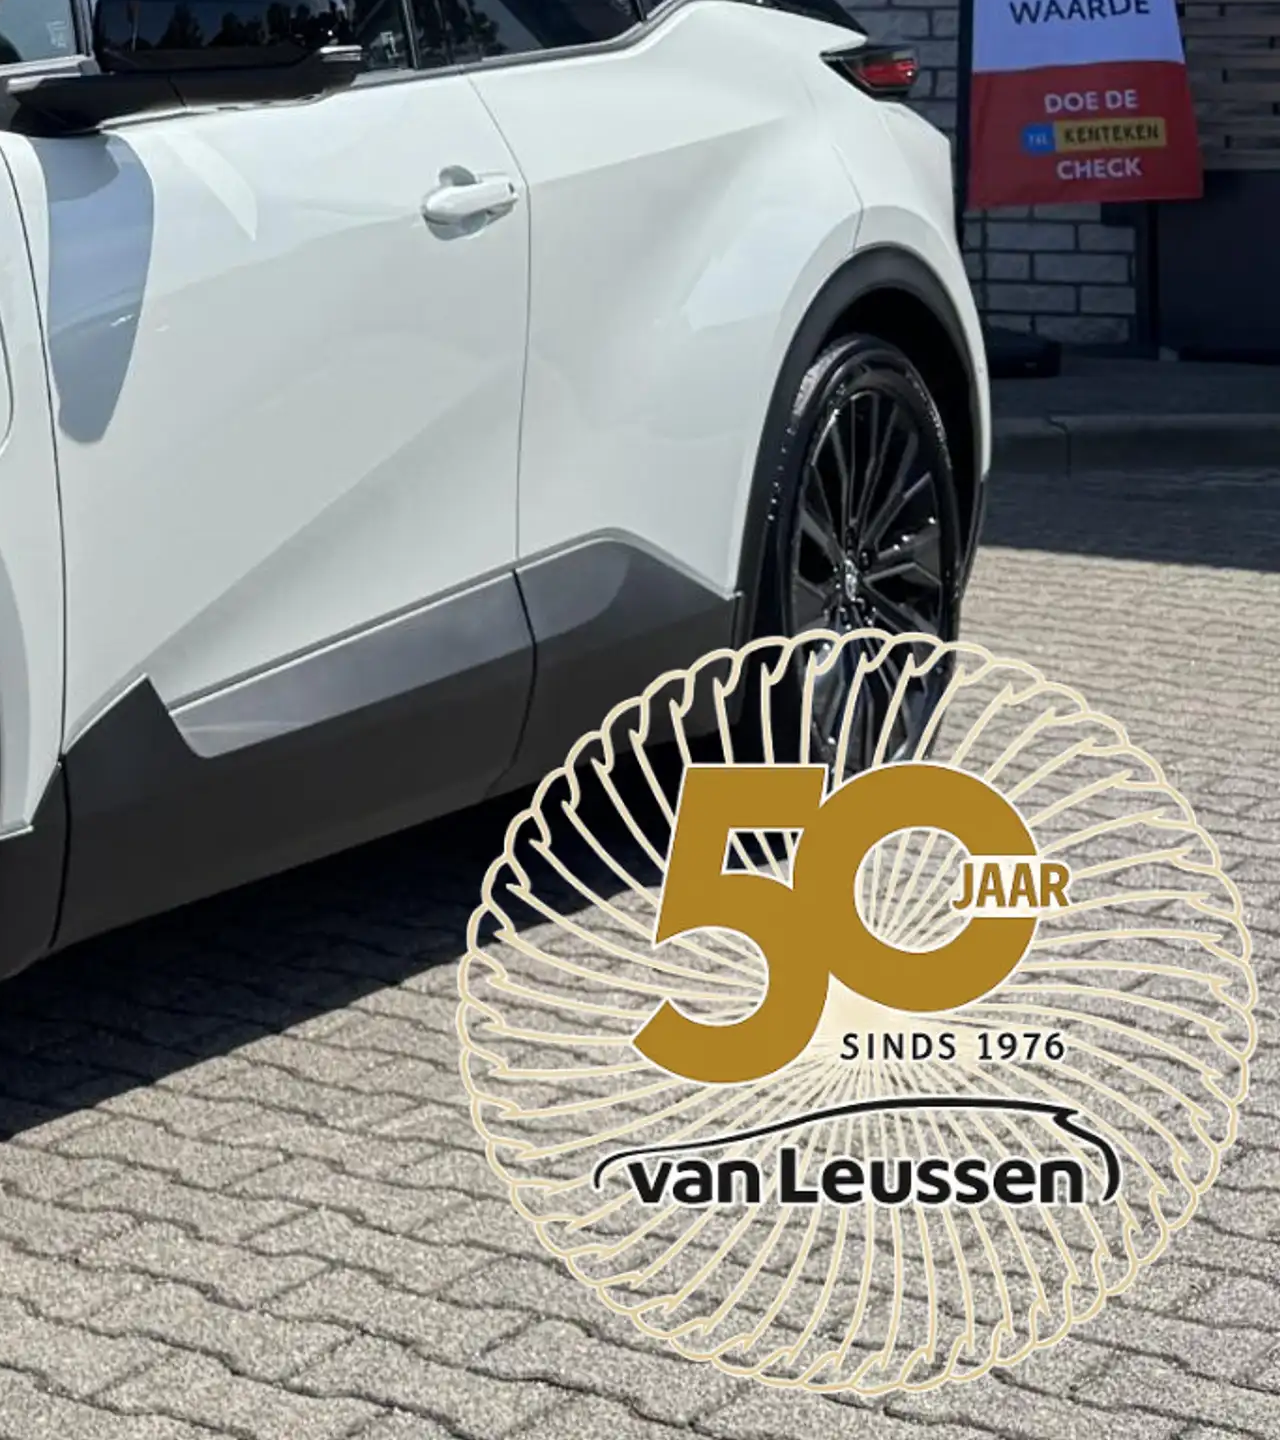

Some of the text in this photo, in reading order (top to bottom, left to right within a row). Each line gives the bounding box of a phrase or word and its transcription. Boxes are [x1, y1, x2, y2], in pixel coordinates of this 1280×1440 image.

[1044, 89, 1140, 114] DOE DE
[1064, 122, 1160, 145] KENTEKEN
[1056, 157, 1144, 180] CHECK
